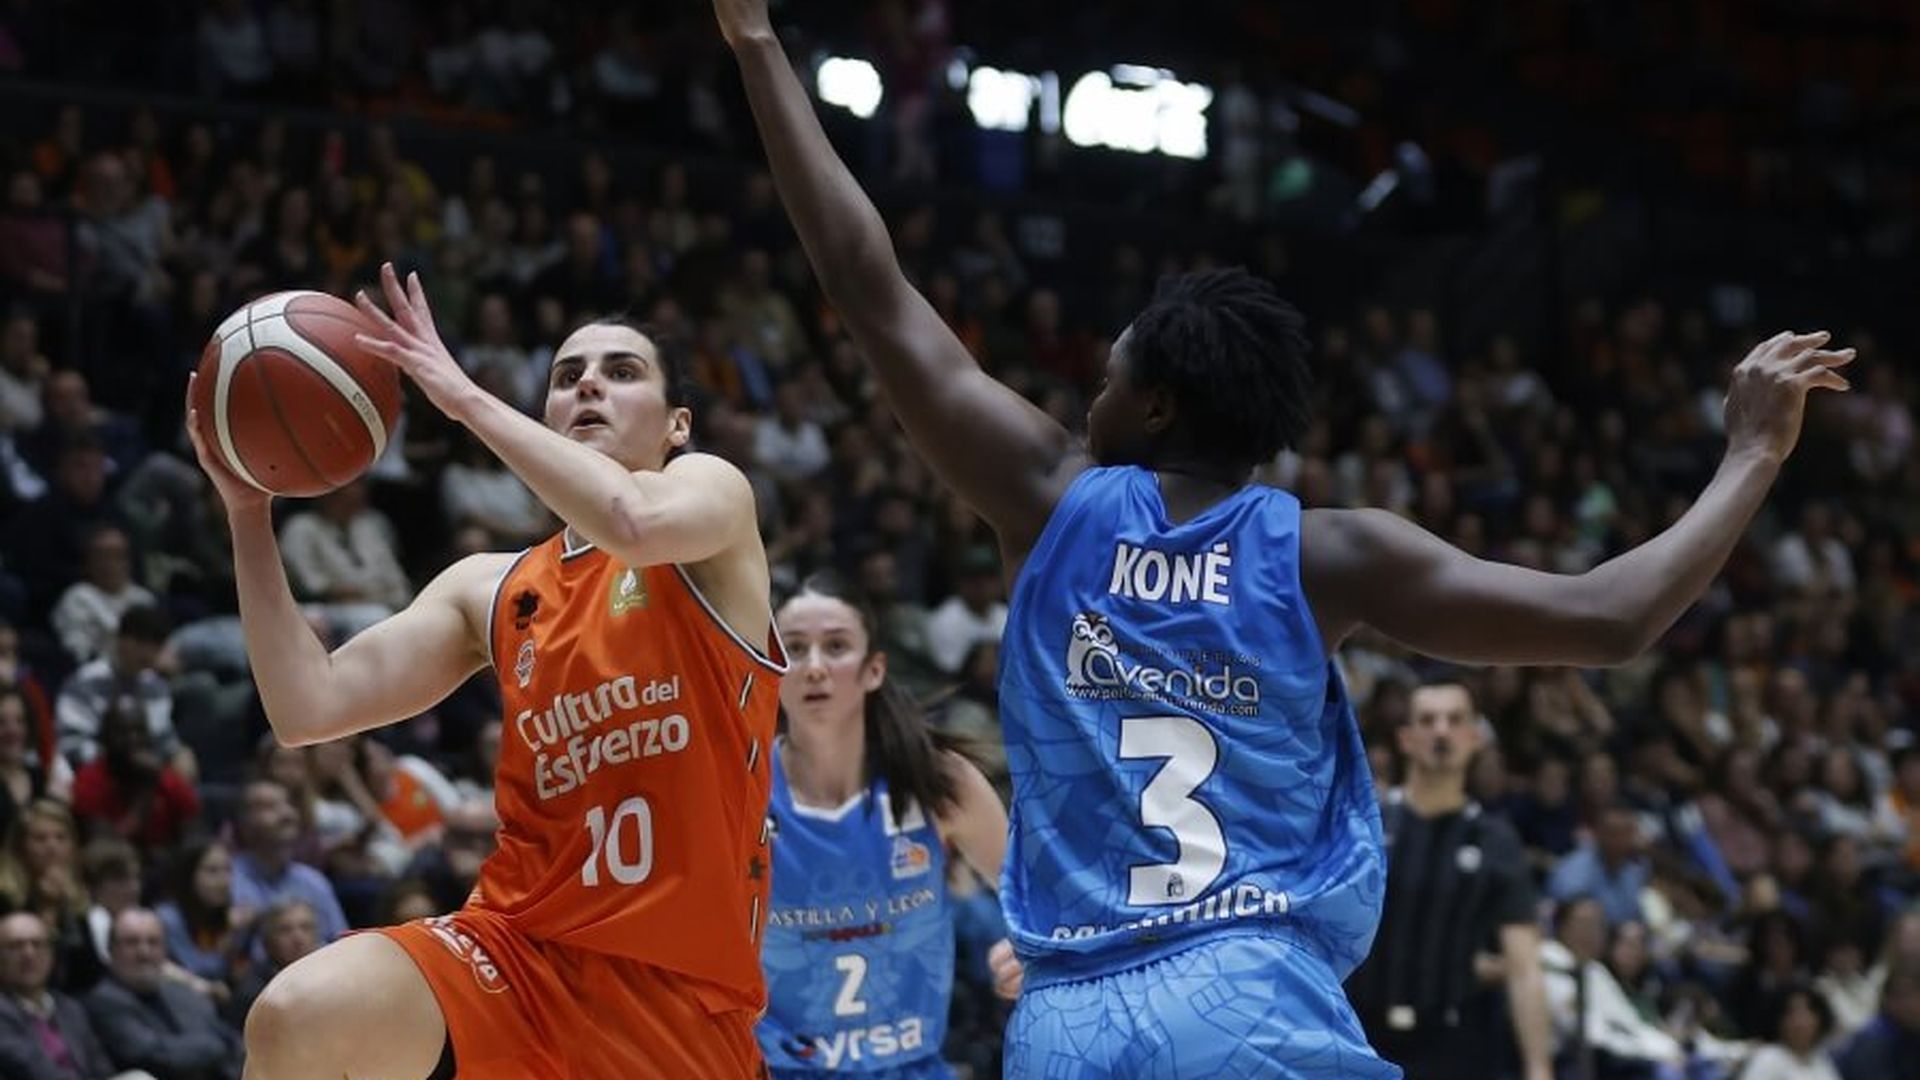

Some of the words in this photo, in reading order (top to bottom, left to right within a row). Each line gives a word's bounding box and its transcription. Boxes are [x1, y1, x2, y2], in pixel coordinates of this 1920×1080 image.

[1109, 542, 1231, 604] KONÉ
[516, 675, 638, 752] Cultura
[642, 675, 679, 705] del
[582, 796, 652, 886] 10
[1118, 717, 1227, 906] 3
[769, 906, 854, 927] ASTILLA
[865, 900, 877, 920] Y
[835, 954, 867, 1016] 2
